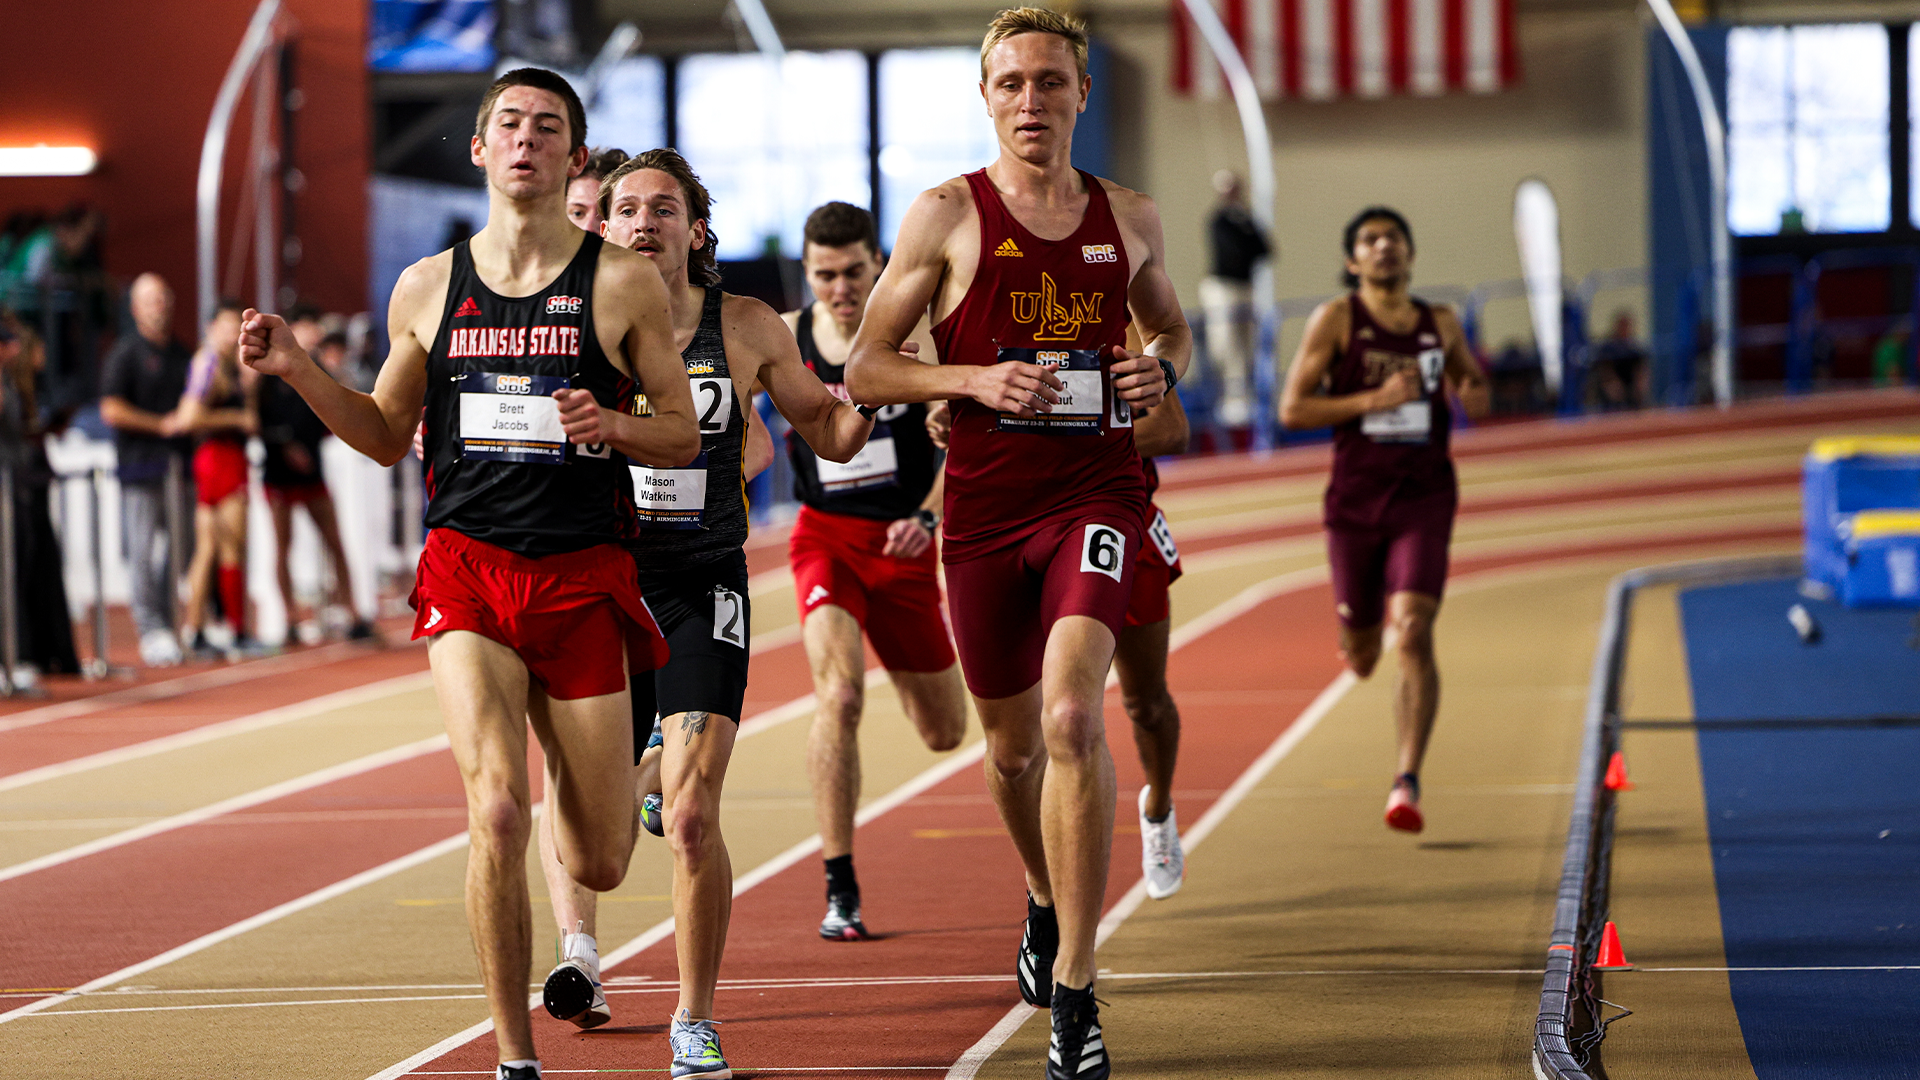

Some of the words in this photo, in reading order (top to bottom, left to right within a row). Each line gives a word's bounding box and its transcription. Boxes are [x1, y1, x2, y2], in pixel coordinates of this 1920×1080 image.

[995, 250, 1024, 258] adidas
[1082, 244, 1117, 263] SBC
[546, 295, 582, 314] SBC
[1010, 272, 1104, 341] ULM
[447, 327, 527, 358] ARKANSAS
[529, 325, 580, 357] STATE
[687, 359, 714, 375] SBC
[1036, 351, 1069, 369] SBC
[496, 375, 531, 394] SBC
[500, 402, 525, 414] Brett
[699, 381, 722, 430] 2
[492, 419, 529, 431] Jacobs
[645, 475, 675, 487] Mason
[641, 490, 677, 502] Watkins
[1088, 529, 1119, 572] 6
[722, 592, 740, 644] 2
